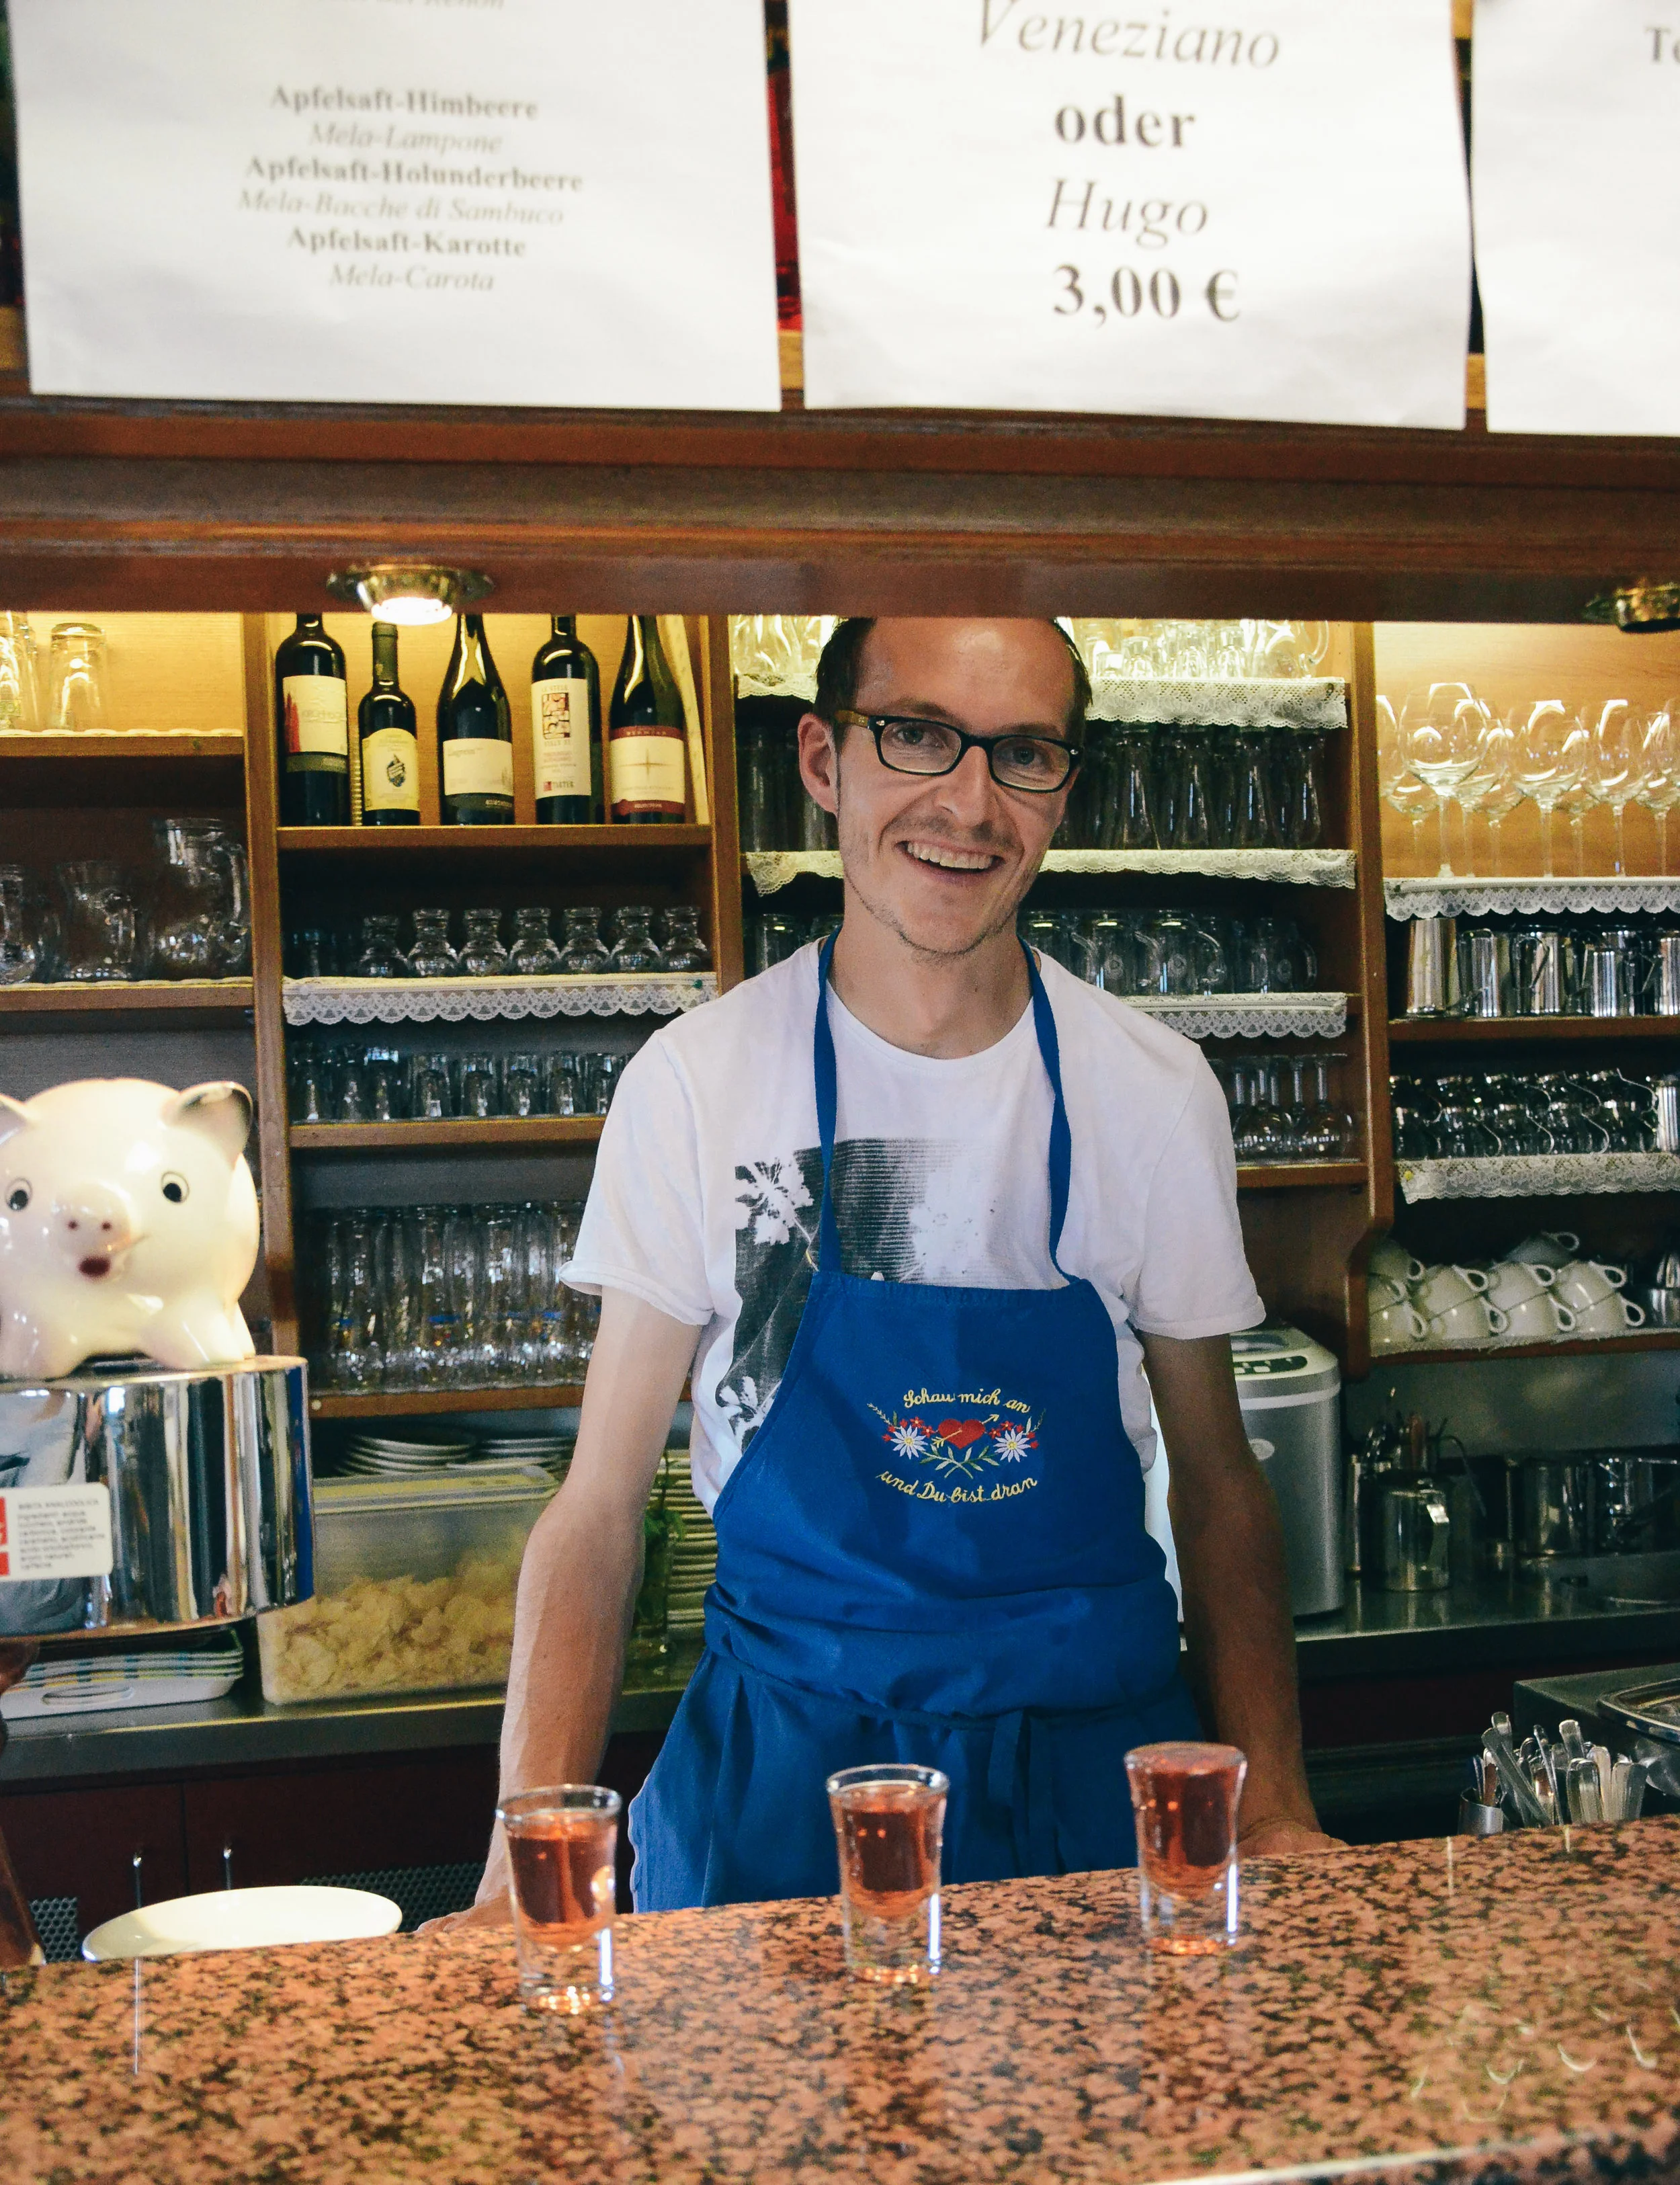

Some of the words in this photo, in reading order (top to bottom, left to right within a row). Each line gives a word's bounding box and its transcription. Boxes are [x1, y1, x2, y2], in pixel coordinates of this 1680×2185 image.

[980, 0, 1279, 68] Veneziano
[269, 85, 540, 120] Apfelsaft-Himbeere
[1054, 93, 1195, 148] oder
[308, 122, 503, 156] Mela-Lampone
[245, 155, 583, 192] Apfelsaft-Holunderbeere
[238, 190, 406, 220] Mela-Bacche
[415, 196, 440, 220] di
[448, 197, 564, 226] Sambuco
[1046, 177, 1209, 249] Hugo
[286, 226, 527, 257] Apfelsaft-Karotte
[329, 263, 495, 292] Mela-Carota
[1052, 264, 1182, 328] 3,00
[1204, 269, 1241, 323] €
[903, 1388, 954, 1407] Schau
[958, 1389, 1001, 1405] mich
[1003, 1399, 1031, 1413] an
[876, 1471, 919, 1495] und
[918, 1481, 948, 1502] Du
[948, 1485, 987, 1503] bist
[988, 1477, 1038, 1500] dran
